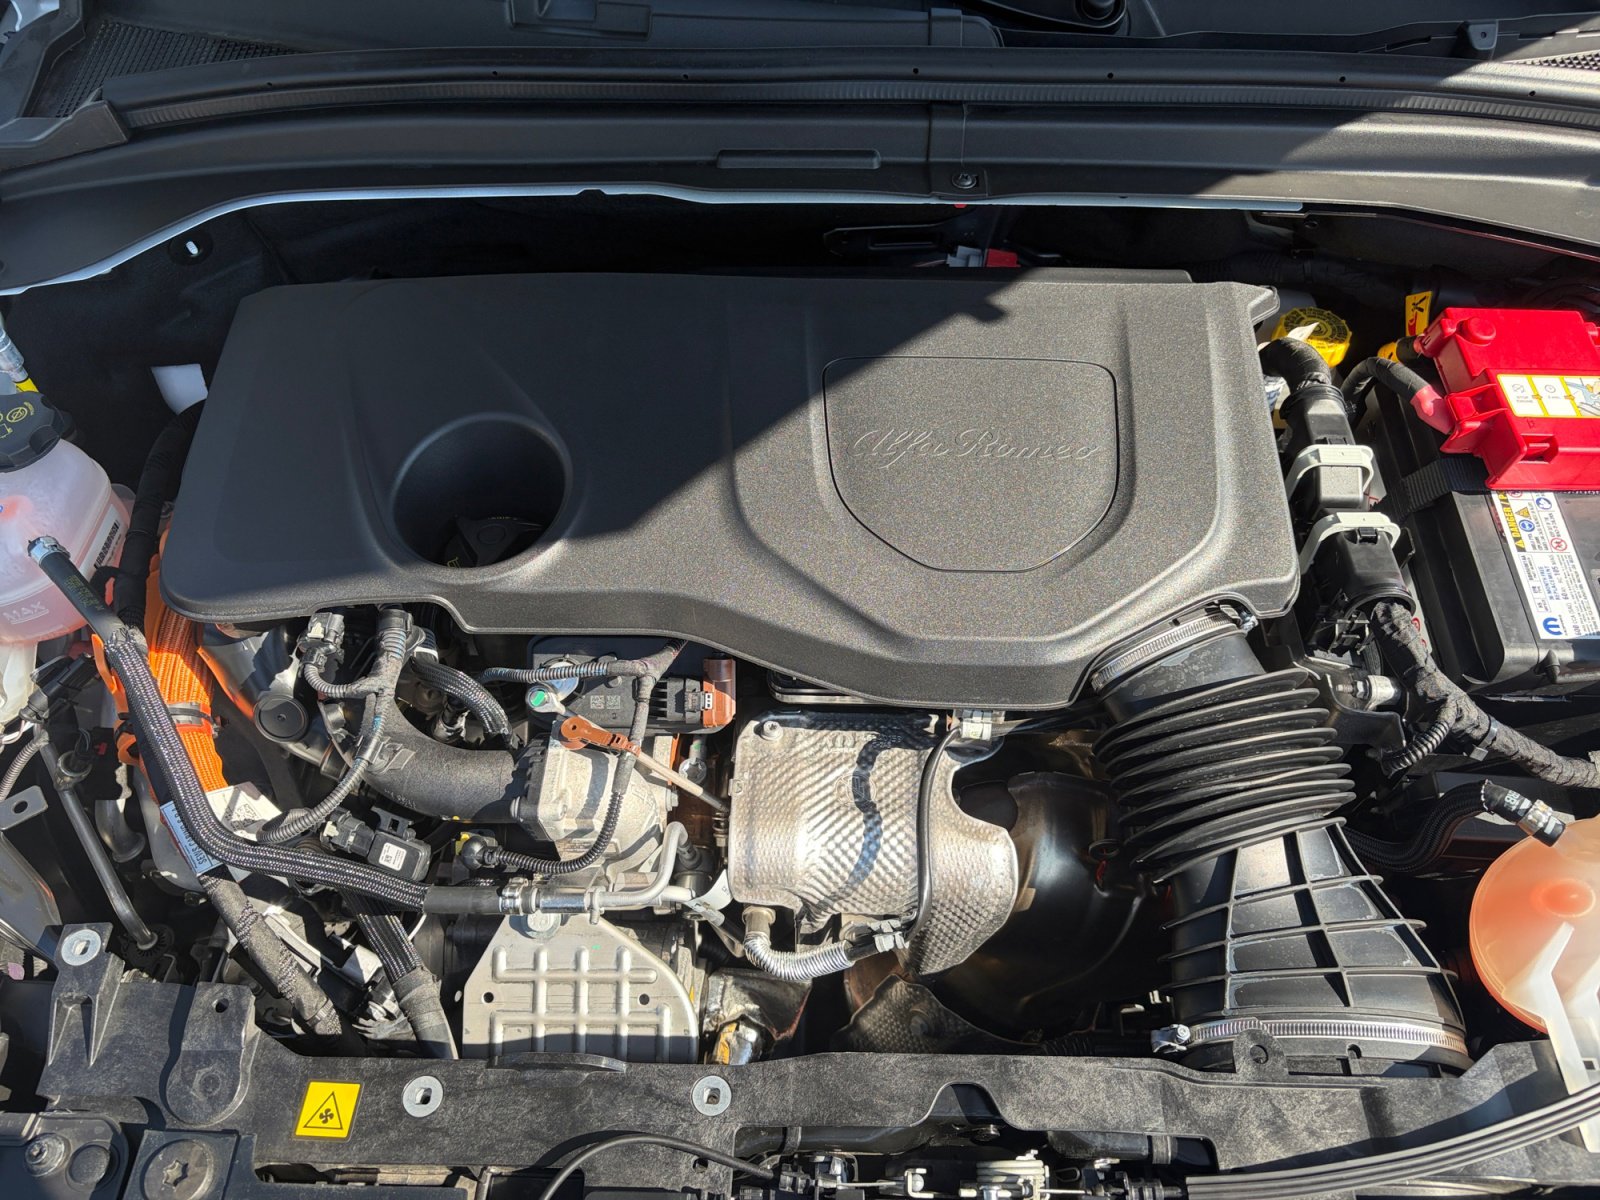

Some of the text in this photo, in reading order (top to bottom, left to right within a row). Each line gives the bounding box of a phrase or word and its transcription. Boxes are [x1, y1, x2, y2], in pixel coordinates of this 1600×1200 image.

[848, 427, 1100, 470] Alfa Romeo
[1502, 507, 1521, 537] DANGER
[192, 845, 207, 864] SEWS
